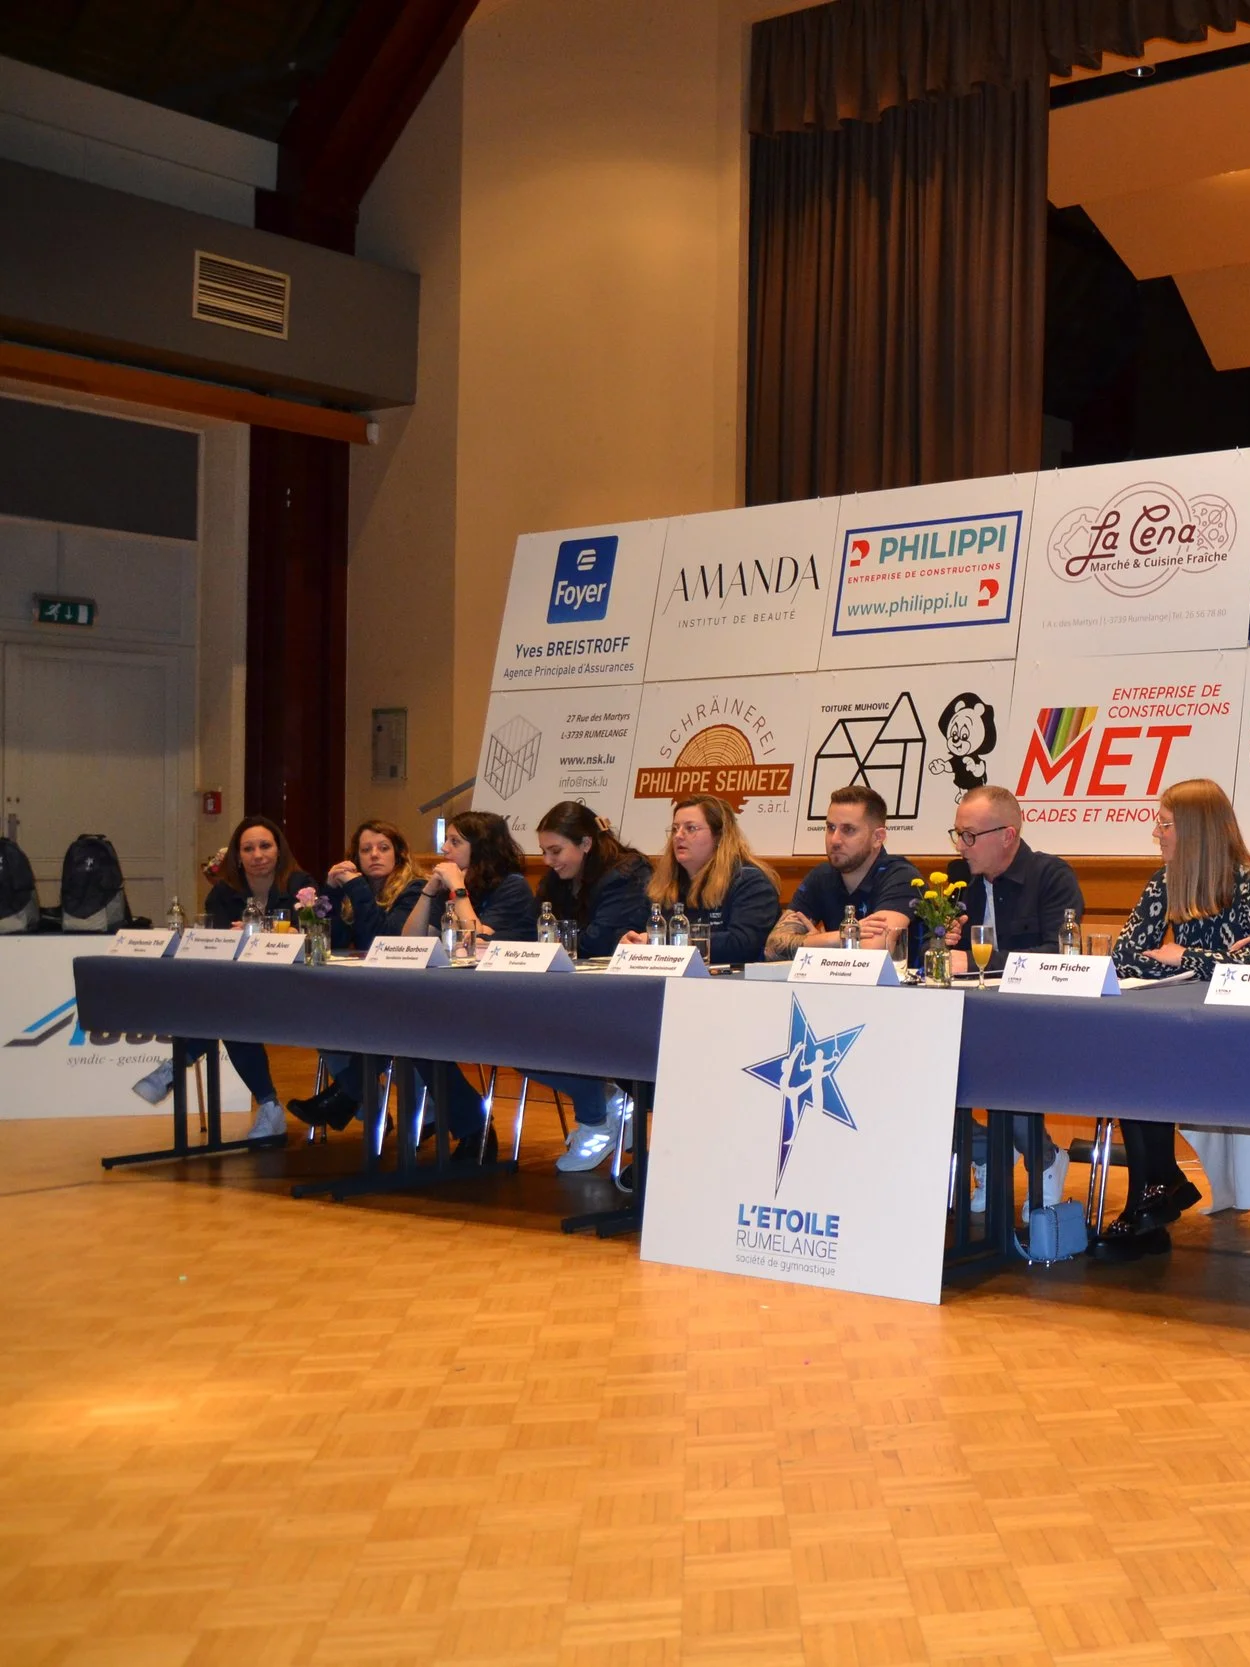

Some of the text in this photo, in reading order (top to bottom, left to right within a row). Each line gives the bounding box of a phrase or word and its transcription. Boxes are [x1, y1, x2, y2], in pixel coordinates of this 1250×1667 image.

[1129, 504, 1197, 555] Cena
[879, 525, 1007, 564] PHILIPPI
[1090, 558, 1130, 573] Marché
[1144, 555, 1184, 568] Cuisine
[1186, 551, 1228, 565] Fraîche
[848, 562, 1001, 584] ENTREPRISE DE CONSTRUCTIONS
[554, 579, 607, 611] Foyer
[661, 553, 821, 616] AMANDA
[847, 592, 968, 618] www.philippi.lu
[678, 608, 797, 629] INSTITUT DE BEAUTÉ
[515, 636, 630, 659] Yves BREISTROFF
[503, 661, 634, 681] Agence Principale d'Assurances
[1112, 684, 1221, 701] ENTREPRISE DE
[576, 714, 589, 723] Rue
[590, 712, 602, 722] des
[603, 712, 630, 722] Martyrs
[820, 702, 890, 713] TOITURE MUHOVIC
[1108, 702, 1231, 719] CONSTRUCTIONS
[584, 729, 628, 739] RUMELANGE
[660, 695, 776, 759] SCHRÄINEREI
[560, 753, 616, 766] www.nsk.lu
[1015, 706, 1192, 797] MET
[639, 769, 790, 793] PHILIPPE SEIMETZ
[1082, 808, 1102, 822] ET
[1105, 808, 1160, 822] RENOV
[504, 950, 520, 959] Kelly
[654, 954, 685, 963] Tintinger
[821, 958, 851, 967] Romain
[1039, 962, 1090, 972] Sam Fischer
[66, 1052, 160, 1067] syndic gestion
[737, 1203, 840, 1238] L'ETOILE
[736, 1229, 838, 1260] RUMELANGE
[735, 1253, 836, 1277] société de gymnastique
